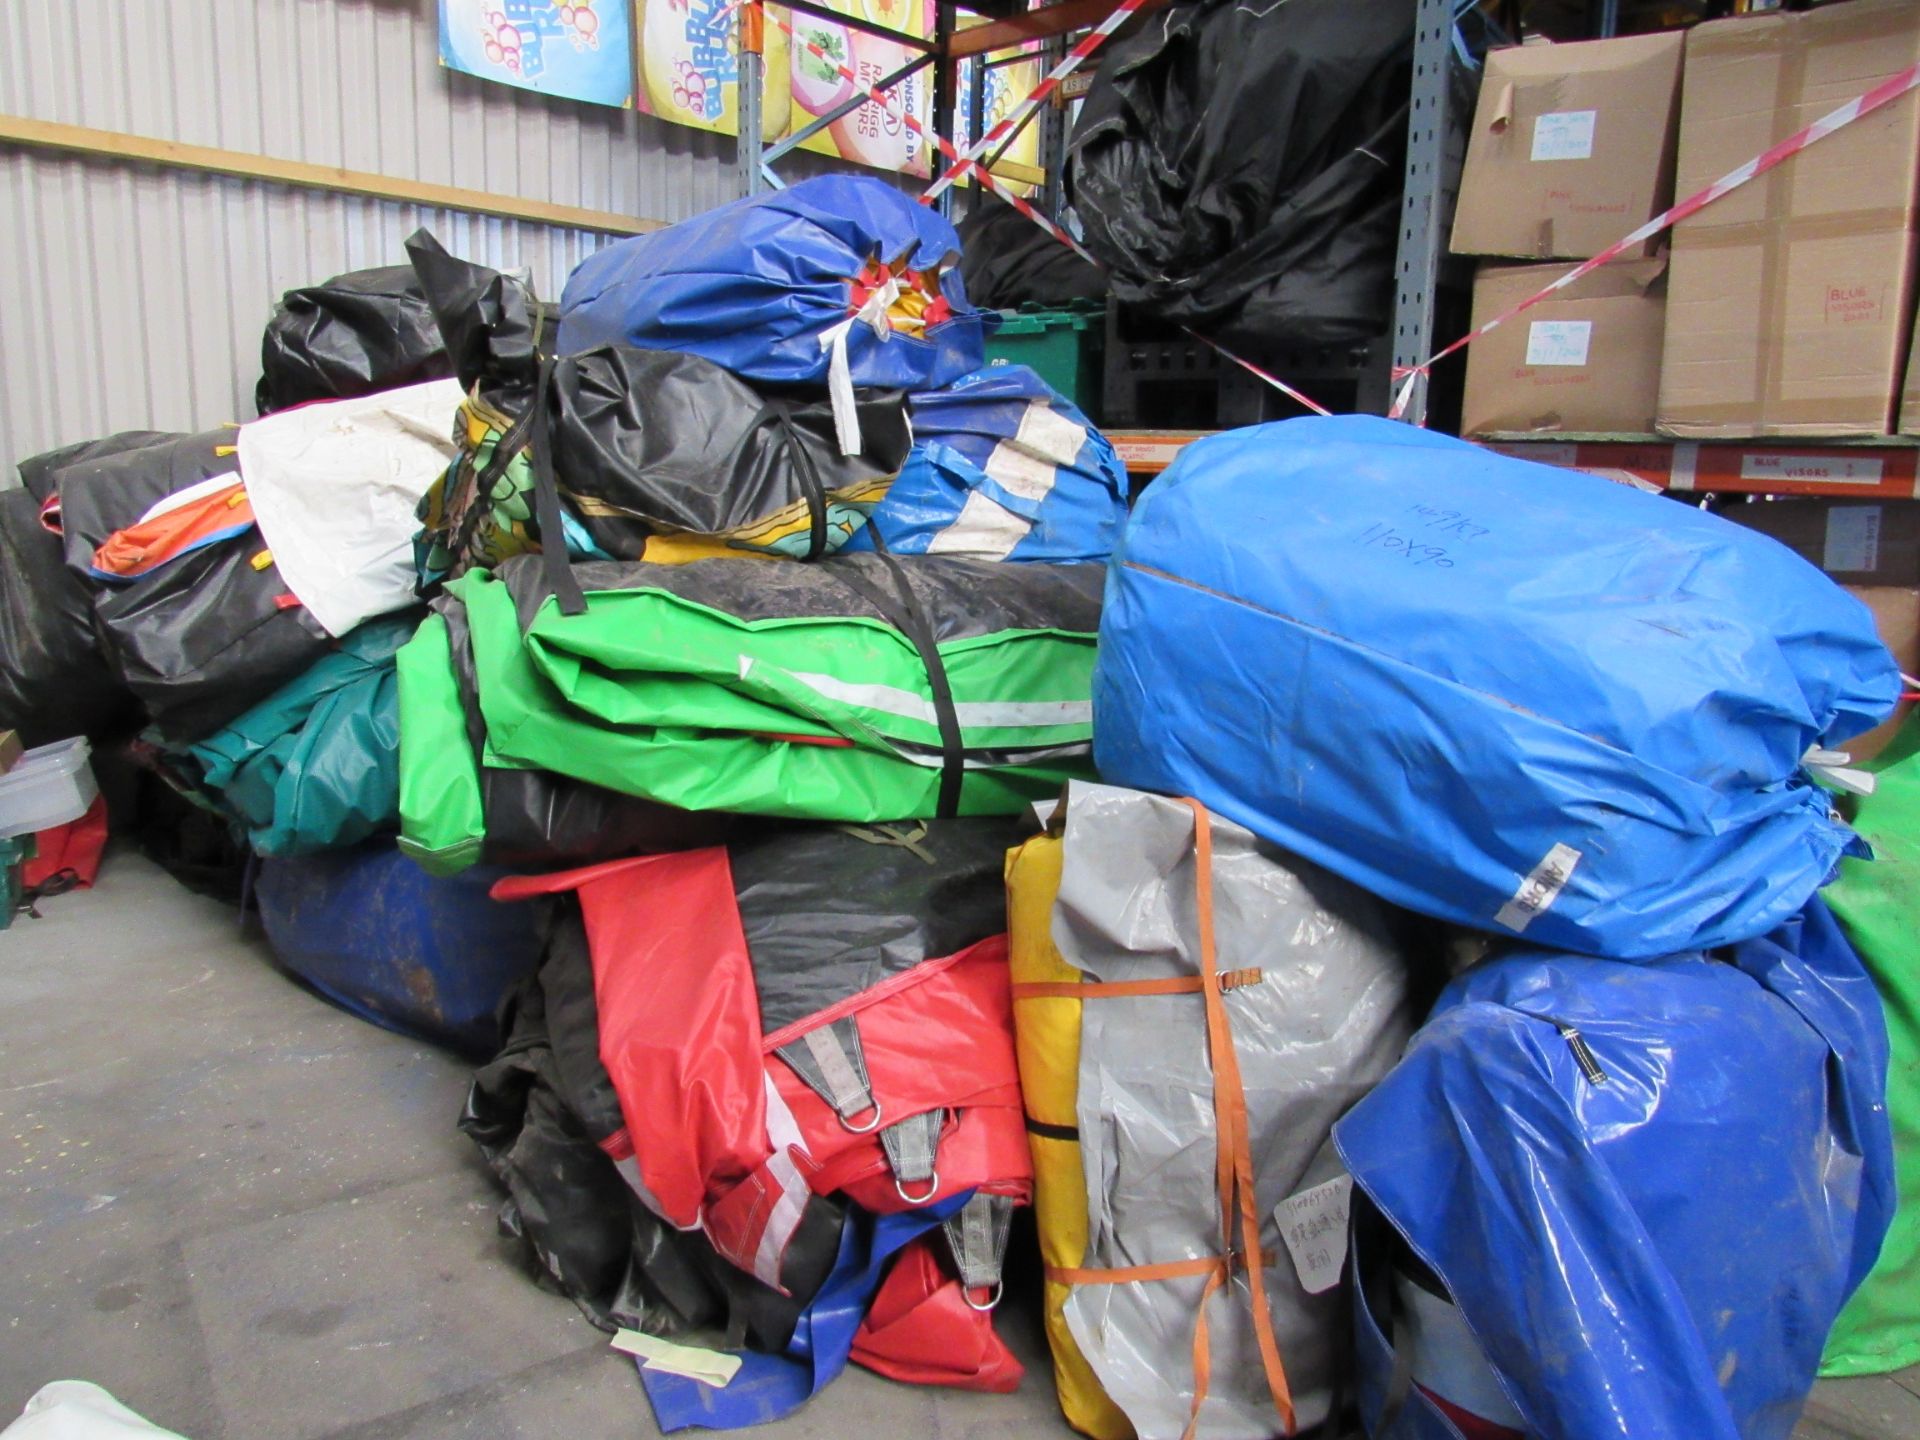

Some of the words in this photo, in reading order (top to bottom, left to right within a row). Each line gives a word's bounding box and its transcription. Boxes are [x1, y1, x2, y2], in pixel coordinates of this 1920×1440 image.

[886, 87, 898, 126] KA
[905, 145, 915, 163] BY
[1830, 287, 1867, 301] BLUE
[1754, 457, 1781, 467] BLUE
[1784, 467, 1830, 479] VISORS
